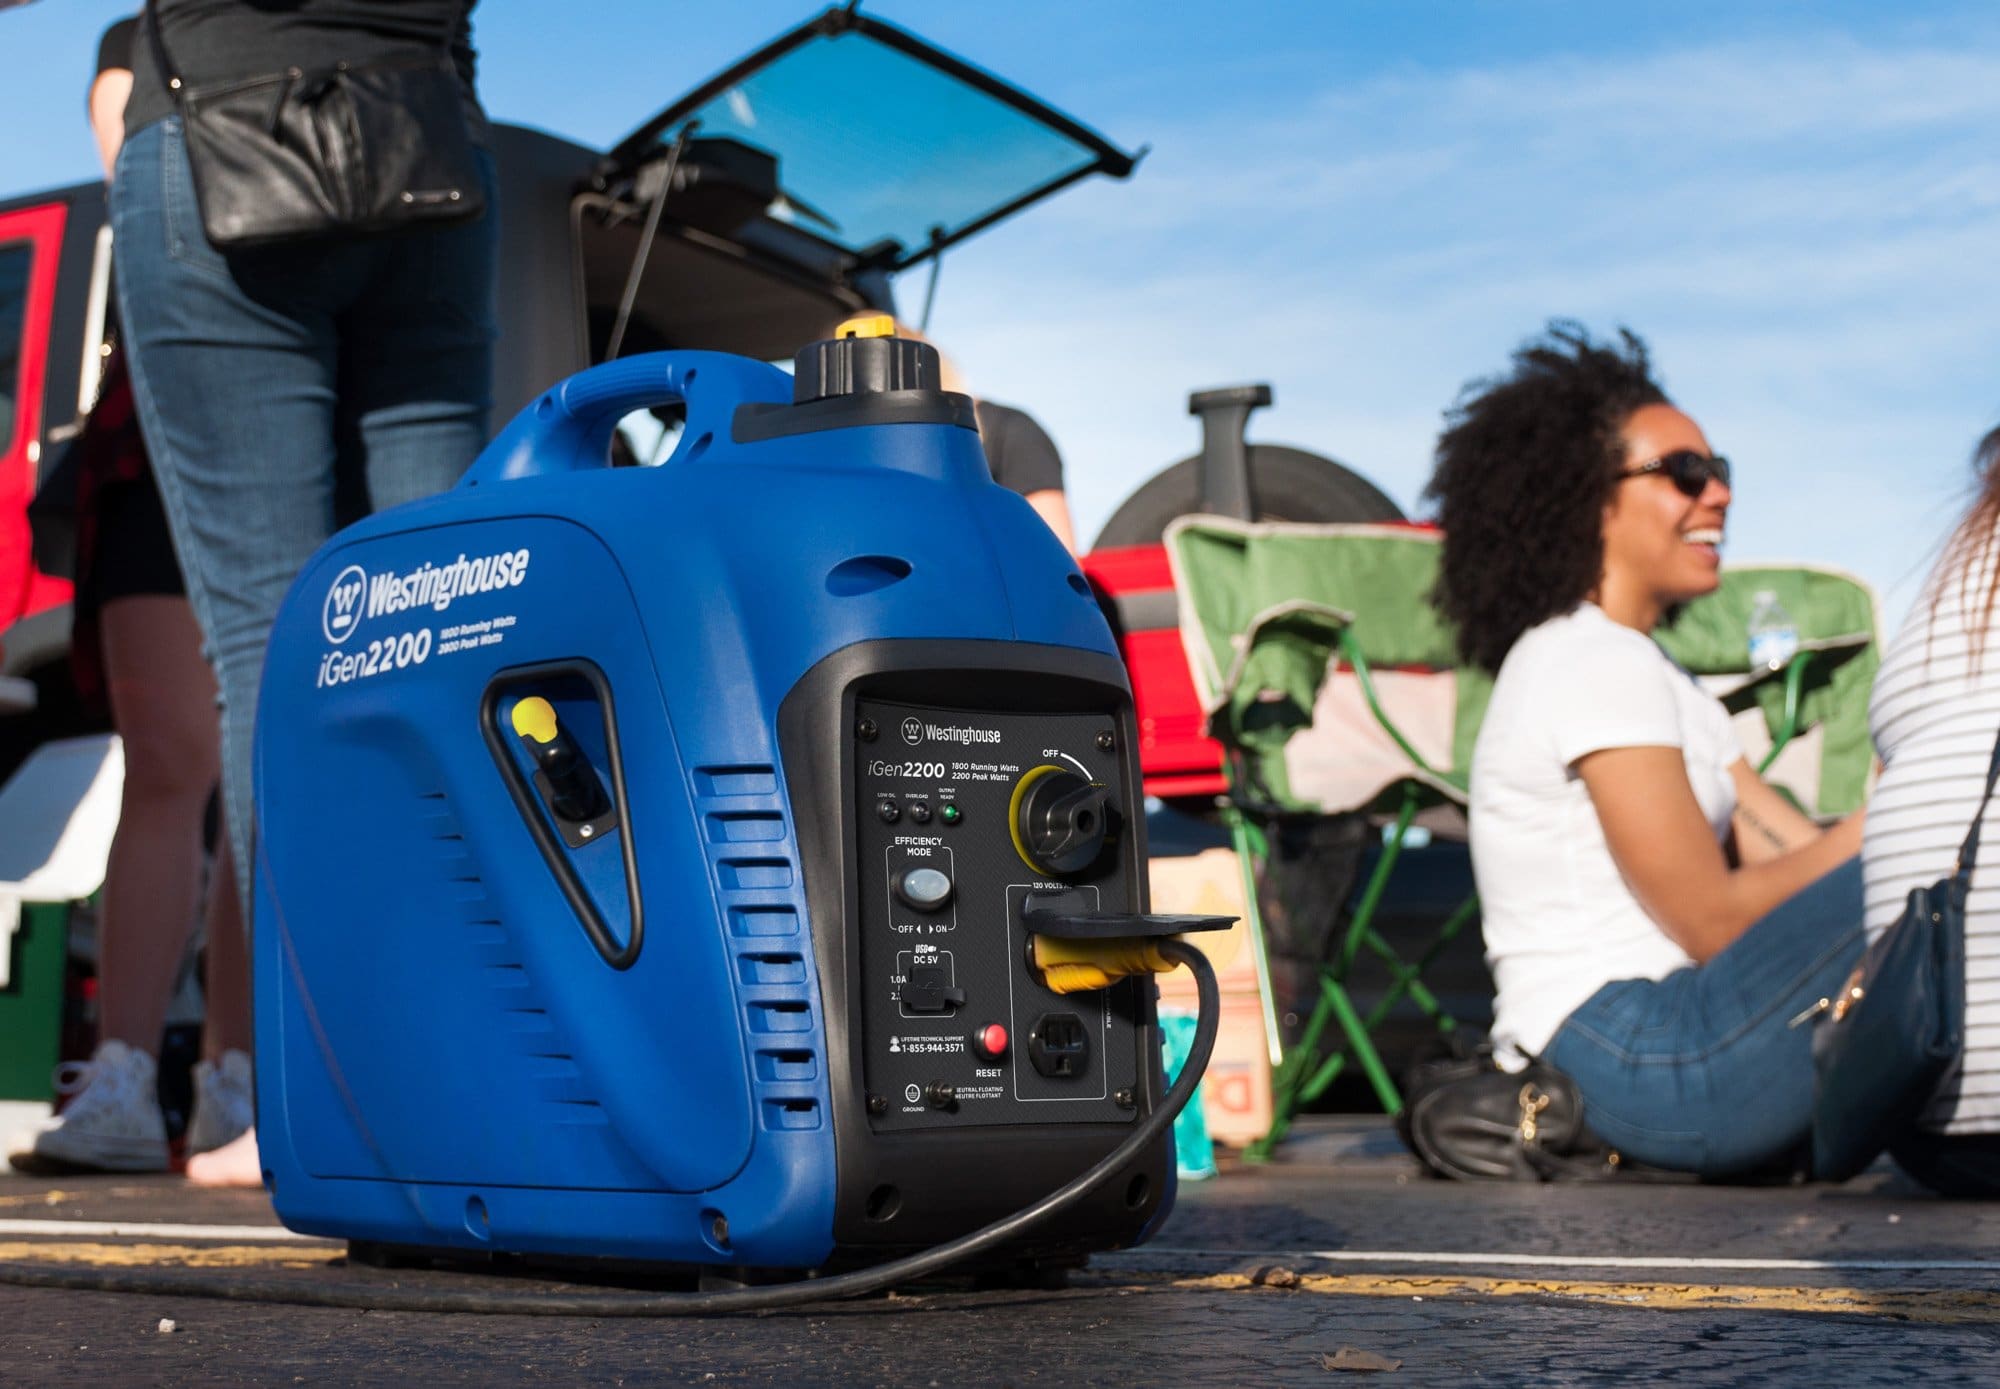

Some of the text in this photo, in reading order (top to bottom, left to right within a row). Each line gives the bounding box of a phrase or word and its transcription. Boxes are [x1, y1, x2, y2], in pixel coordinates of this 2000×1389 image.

[367, 549, 530, 619] Westinghouse
[493, 615, 518, 629] Watts
[480, 632, 504, 646] Watts
[316, 628, 433, 688] iGen2200
[925, 723, 1001, 745] Westinghouse
[1042, 749, 1059, 758] OFF
[868, 760, 946, 779] iGen2200
[951, 762, 1020, 772] 1800 Running Watts
[951, 772, 1010, 781] 2200 Peak Watts
[894, 836, 943, 846] EFFICIENCY
[907, 848, 932, 857] MODE
[1032, 881, 1044, 889] 120
[1044, 881, 1064, 890] VOLTS
[898, 924, 948, 934] OFF ON
[913, 955, 938, 964] DC 5V
[890, 975, 907, 984] 1.0A
[902, 1043, 965, 1053] 1-855-944-3571
[976, 1069, 1003, 1078] RESET
